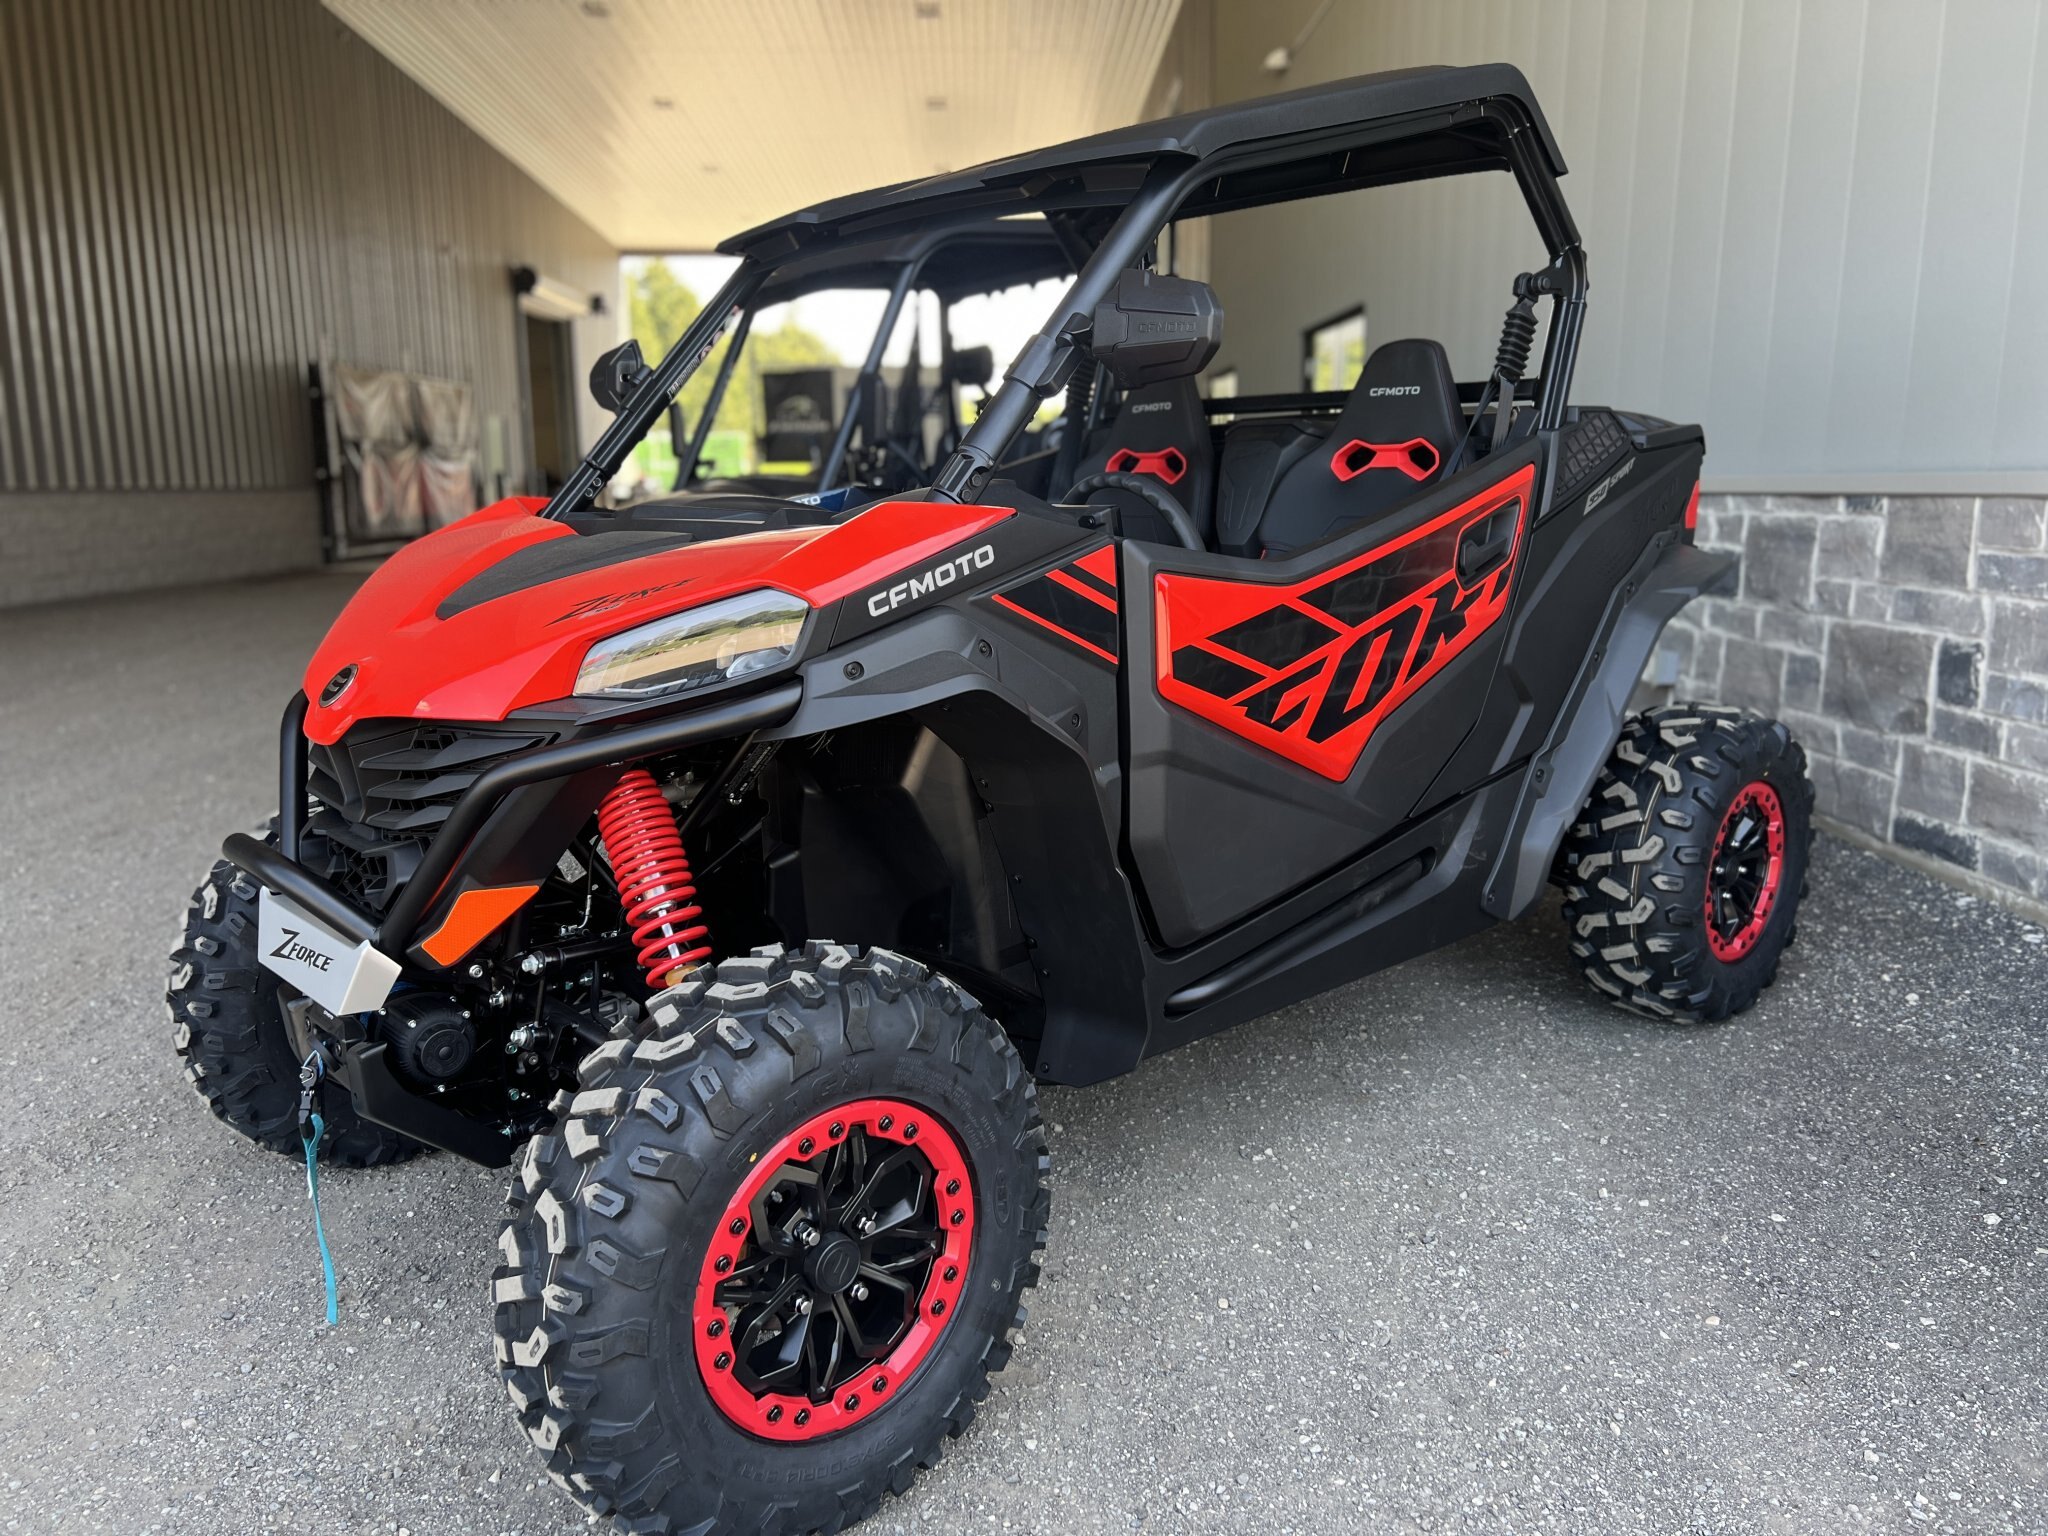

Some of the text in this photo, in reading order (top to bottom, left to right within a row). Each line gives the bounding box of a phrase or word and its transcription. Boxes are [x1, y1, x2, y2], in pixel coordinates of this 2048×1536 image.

[1369, 385, 1421, 397] CFMOTO
[1131, 402, 1172, 413] CFMOTO
[867, 544, 995, 617] CFMOTO
[269, 927, 335, 972] ZFORCE
